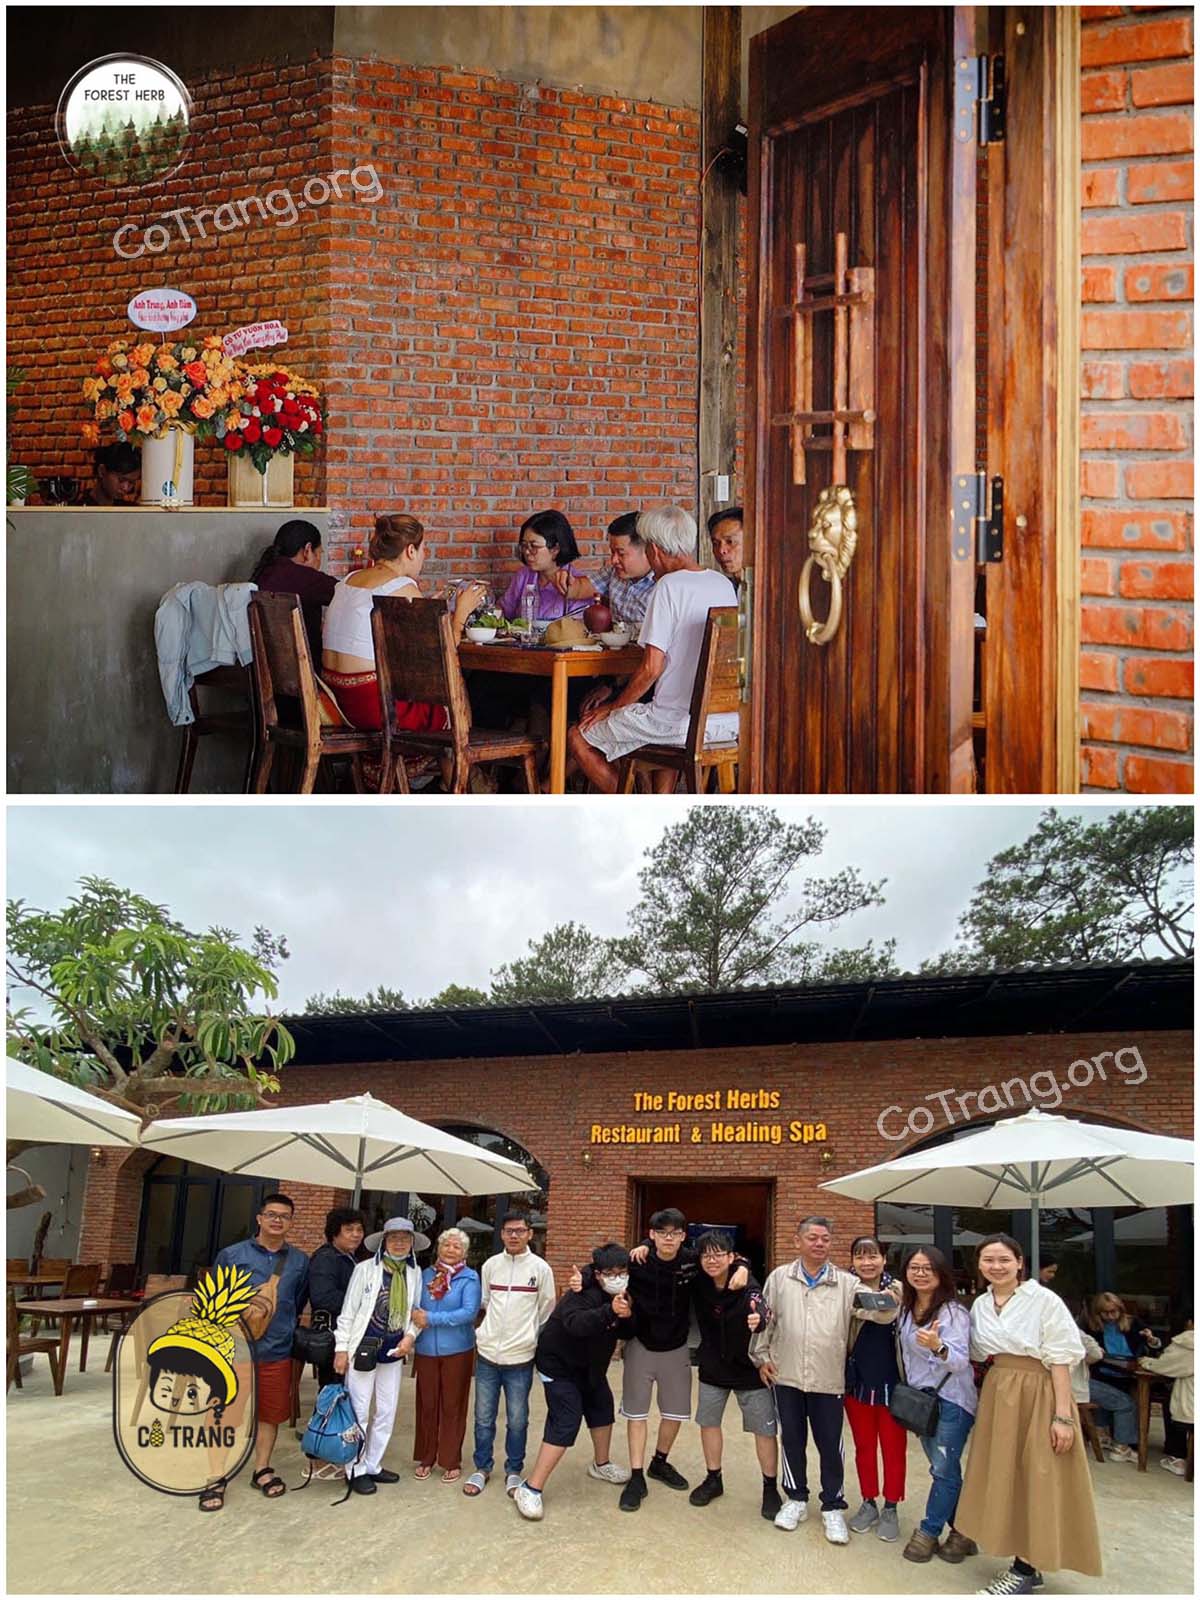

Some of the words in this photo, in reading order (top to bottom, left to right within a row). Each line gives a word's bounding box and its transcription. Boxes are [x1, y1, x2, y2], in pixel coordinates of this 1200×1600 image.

[633, 1092, 663, 1112] The
[667, 1091, 721, 1111] Forest
[727, 1089, 781, 1110] Herbs
[591, 1124, 680, 1144] Restaurant
[691, 1126, 702, 1144] &
[711, 1122, 782, 1145] Healing
[789, 1120, 827, 1145] Spa
